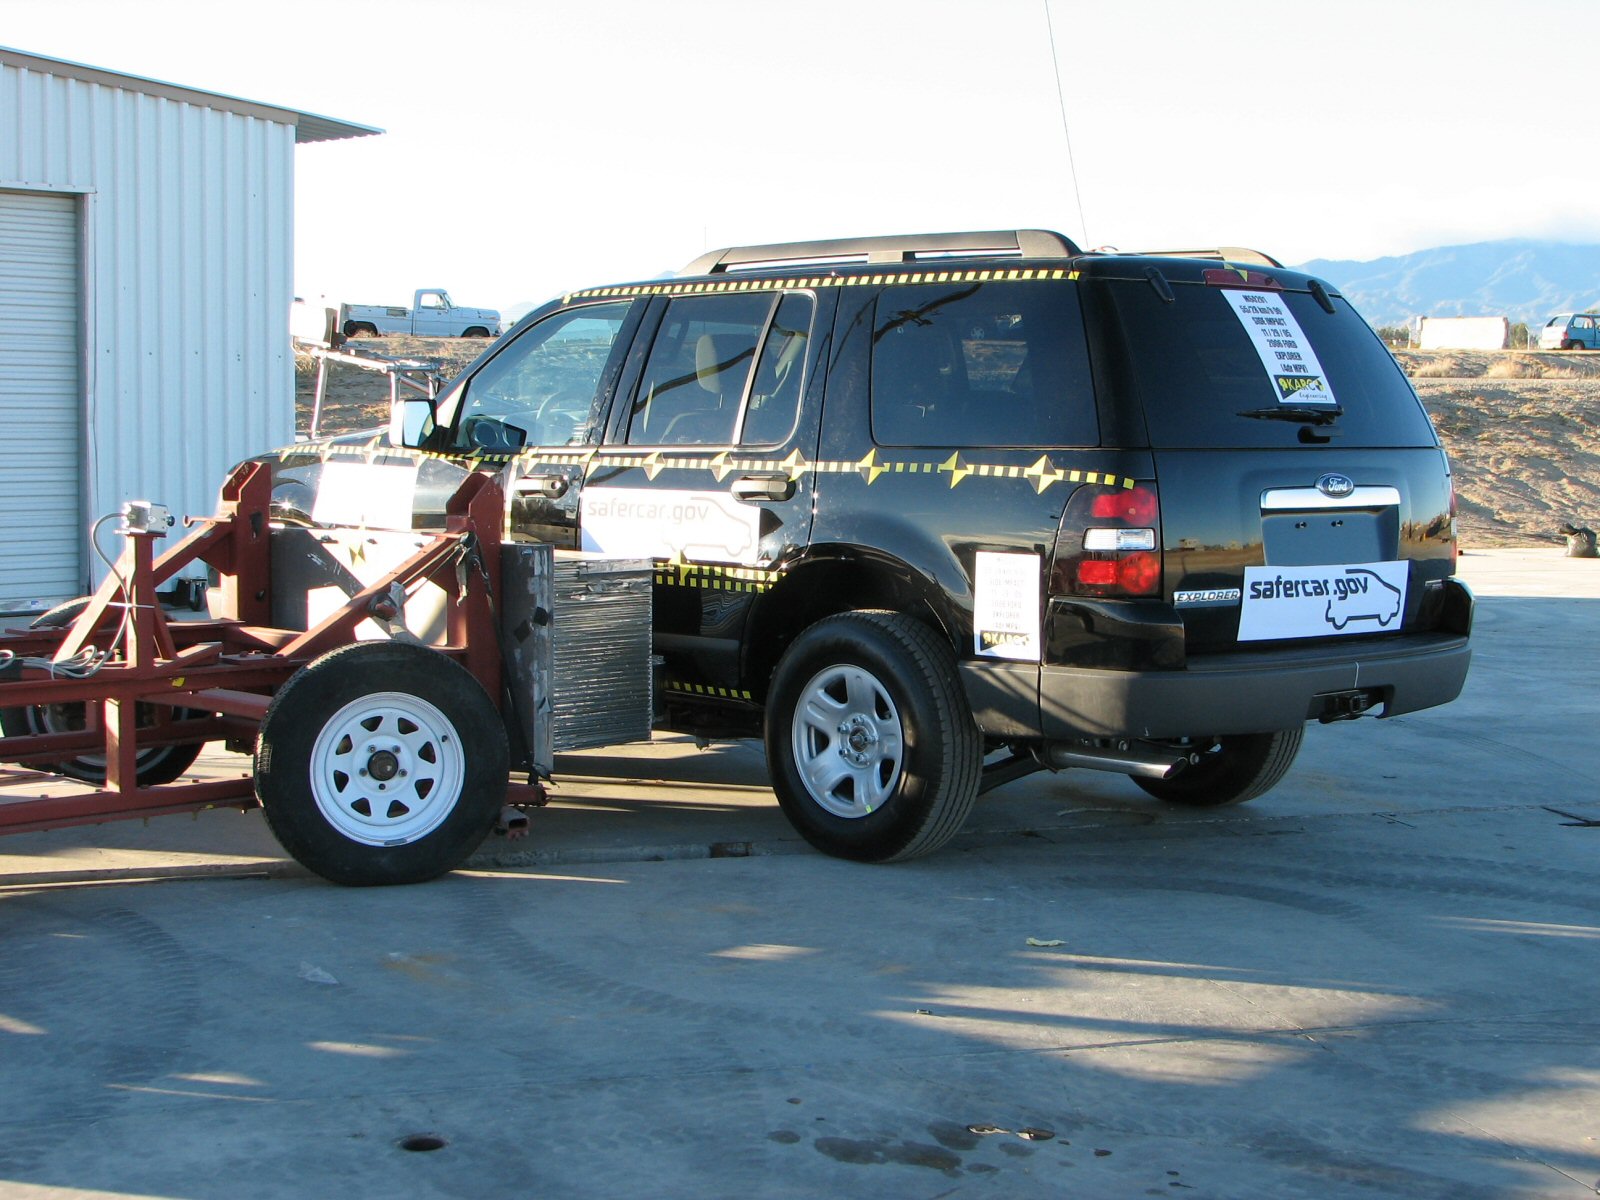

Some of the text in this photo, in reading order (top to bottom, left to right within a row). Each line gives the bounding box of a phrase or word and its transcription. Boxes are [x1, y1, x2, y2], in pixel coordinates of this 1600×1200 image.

[1252, 316, 1287, 327] SIDE IMPACT
[1282, 339, 1298, 349] FORD
[1274, 351, 1303, 361] EXPLORER
[1328, 477, 1348, 491] Ford
[587, 497, 709, 525] safercar.gov
[1249, 574, 1369, 601] safercar.gov
[1177, 590, 1239, 602] EXPLORER
